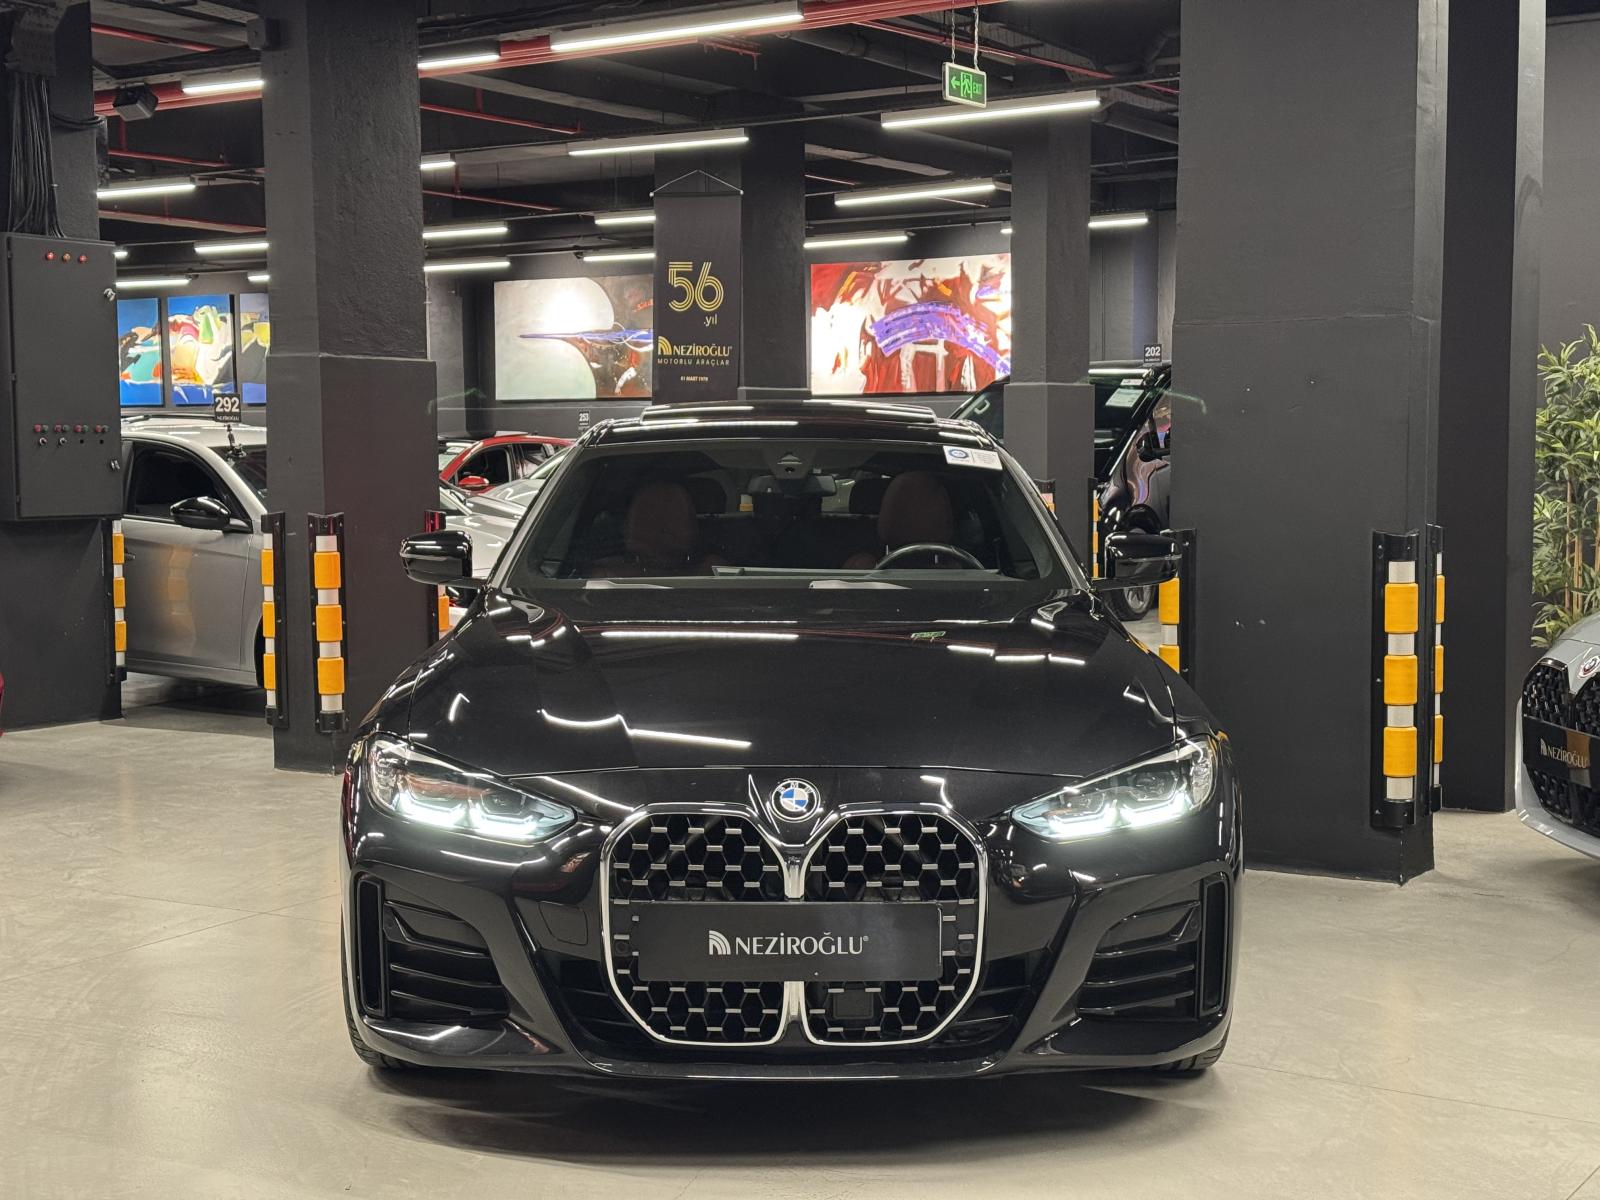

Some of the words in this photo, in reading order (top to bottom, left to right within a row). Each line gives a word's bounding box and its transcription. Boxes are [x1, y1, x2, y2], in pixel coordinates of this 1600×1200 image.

[668, 261, 724, 311] 56
[673, 343, 730, 357] NEZİROĞLU
[1144, 346, 1161, 357] 202
[695, 358, 730, 367] ARAÇLAR
[215, 396, 240, 412] 292
[1548, 745, 1587, 769] NEZİROĞLU
[735, 931, 864, 955] NEZİROĞLU
